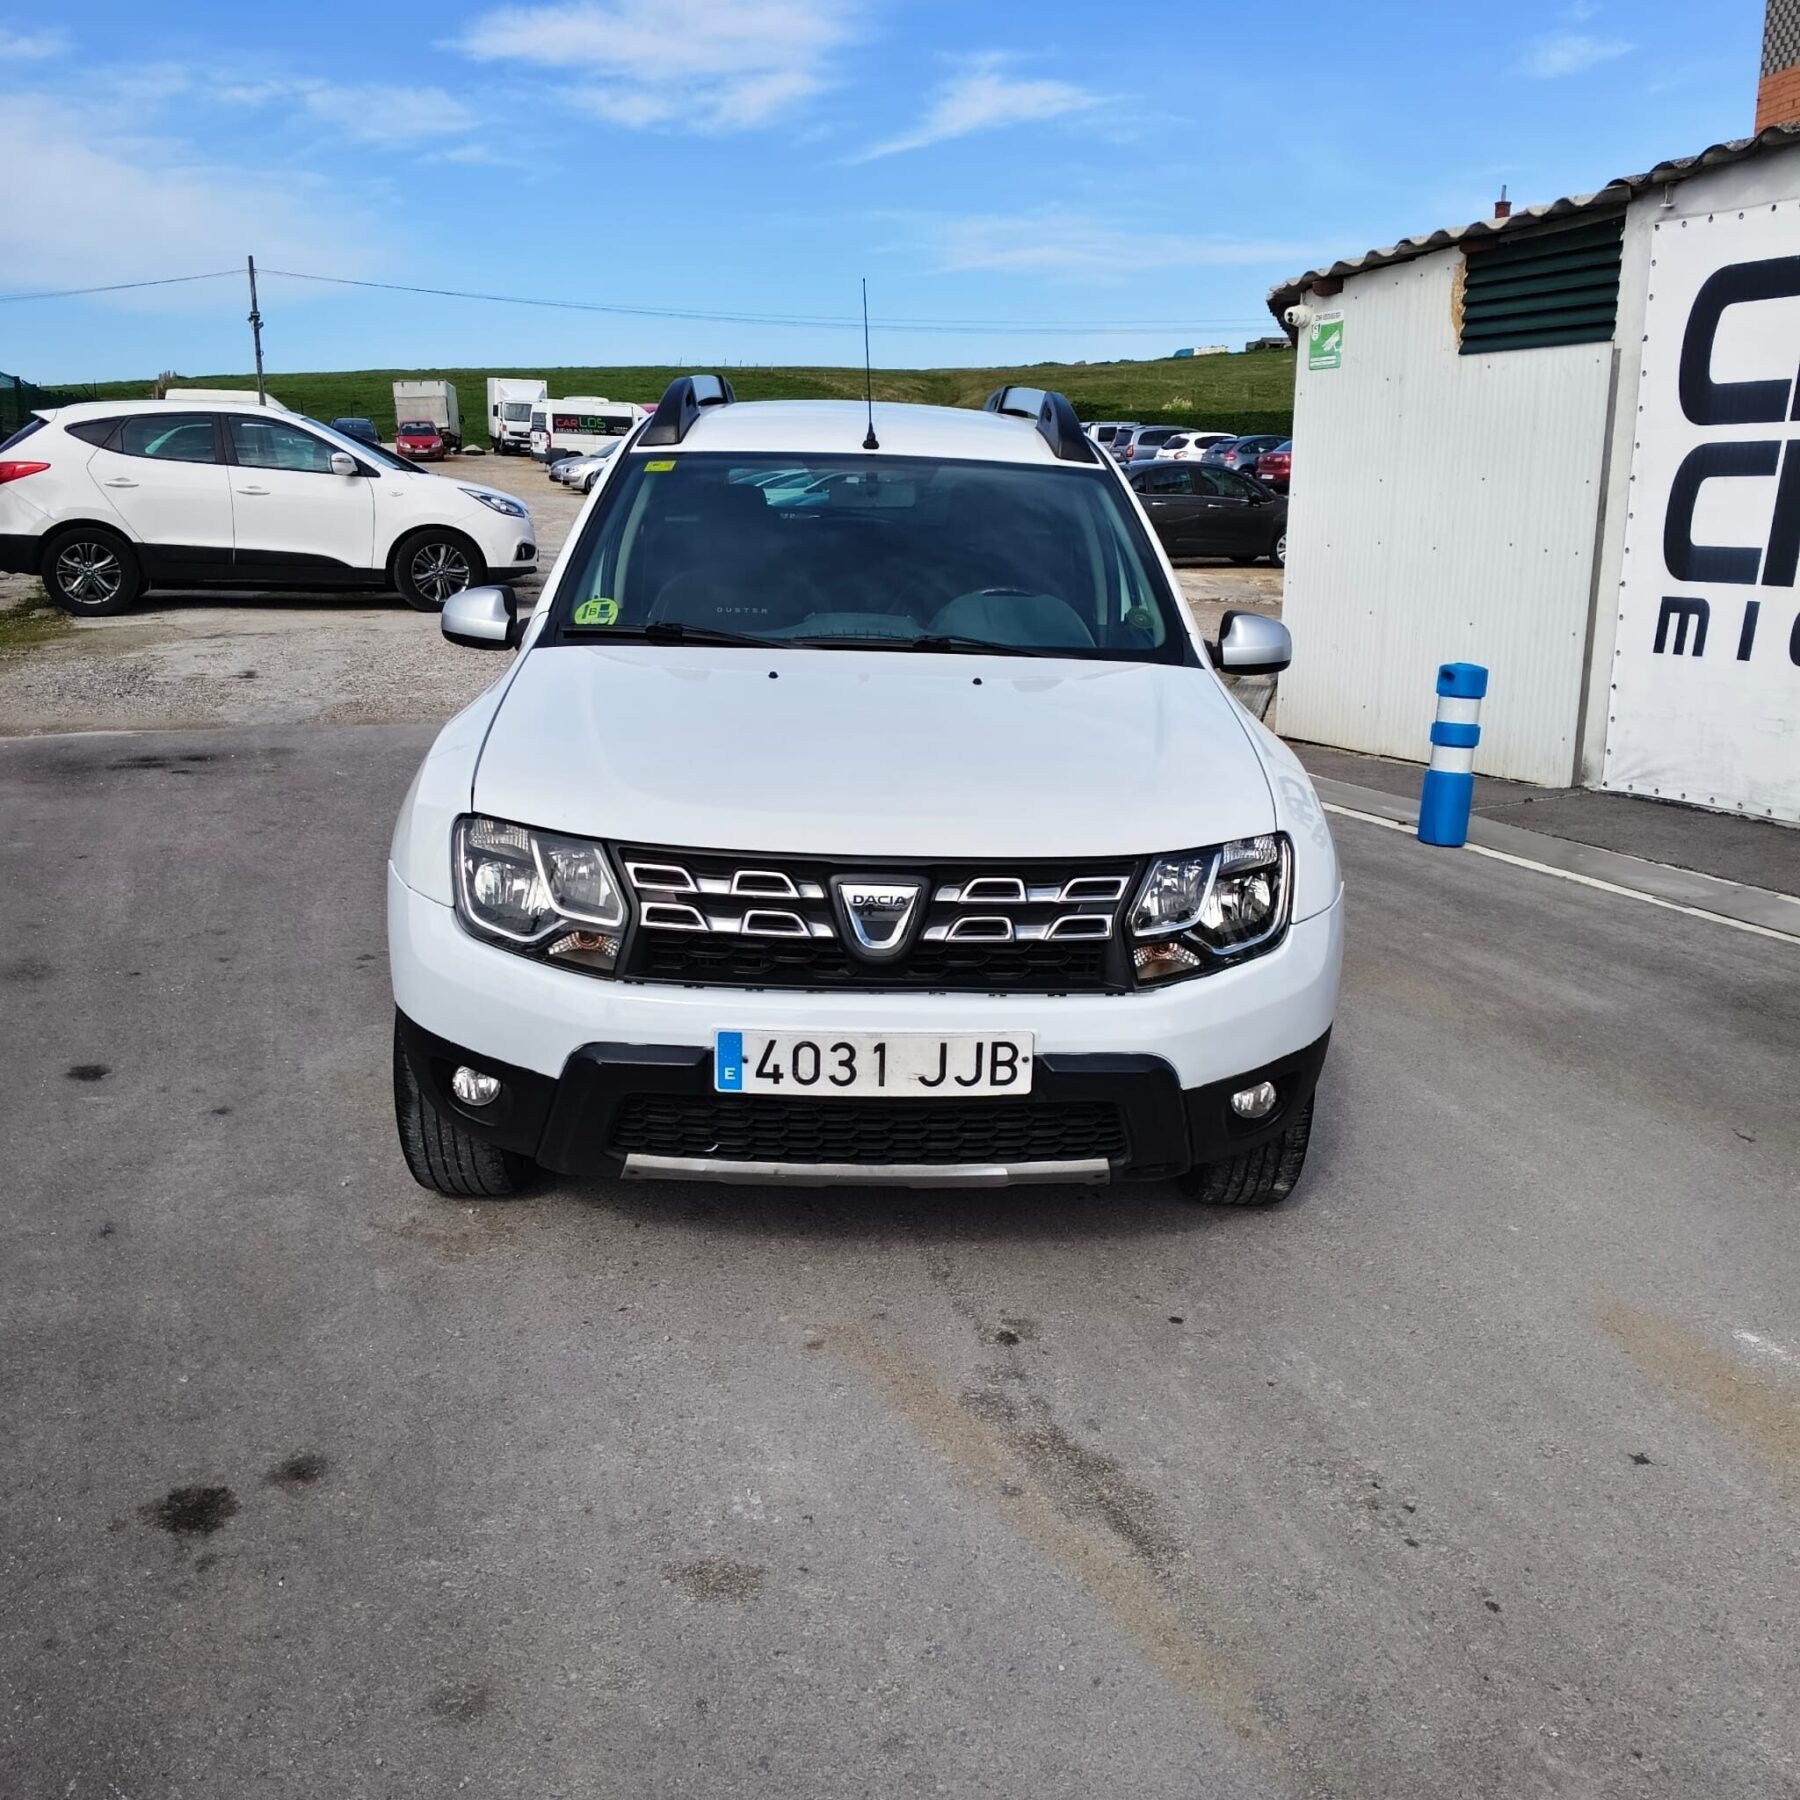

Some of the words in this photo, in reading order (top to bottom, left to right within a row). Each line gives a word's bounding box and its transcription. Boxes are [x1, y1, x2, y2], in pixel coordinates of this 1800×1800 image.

[556, 416, 606, 429] CARLOS
[852, 894, 907, 905] DACIA
[755, 1039, 887, 1087] 4031
[918, 1041, 1019, 1087] JJB
[724, 1067, 736, 1080] E
